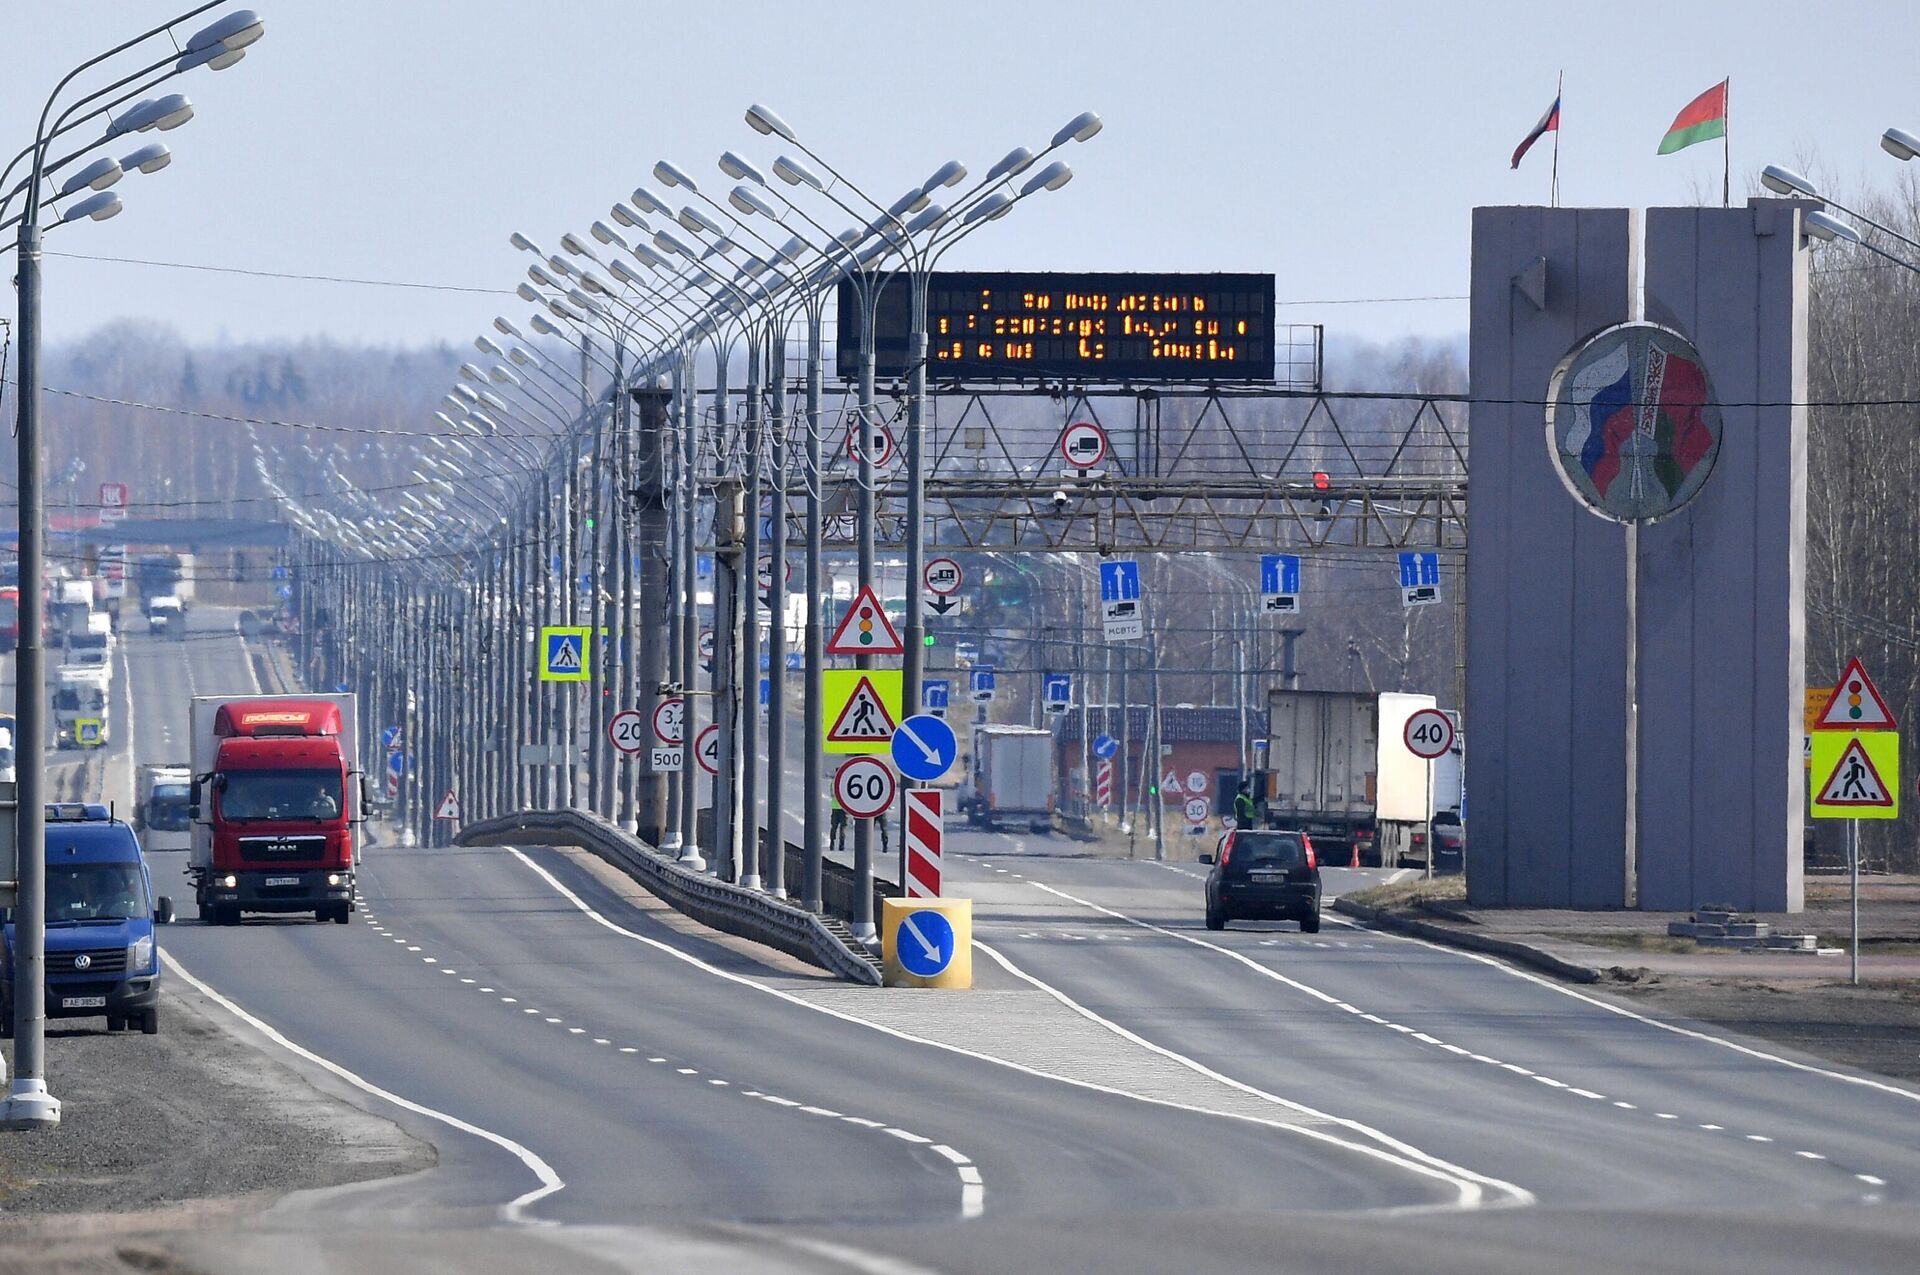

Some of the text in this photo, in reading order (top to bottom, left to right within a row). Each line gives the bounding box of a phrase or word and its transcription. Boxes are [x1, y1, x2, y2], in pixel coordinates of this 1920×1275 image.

[1412, 723, 1443, 743] 40
[705, 740, 718, 760] 4
[654, 753, 681, 766] 500
[847, 774, 884, 800] 60
[1189, 804, 1204, 816] 30
[267, 844, 297, 852] MAN
